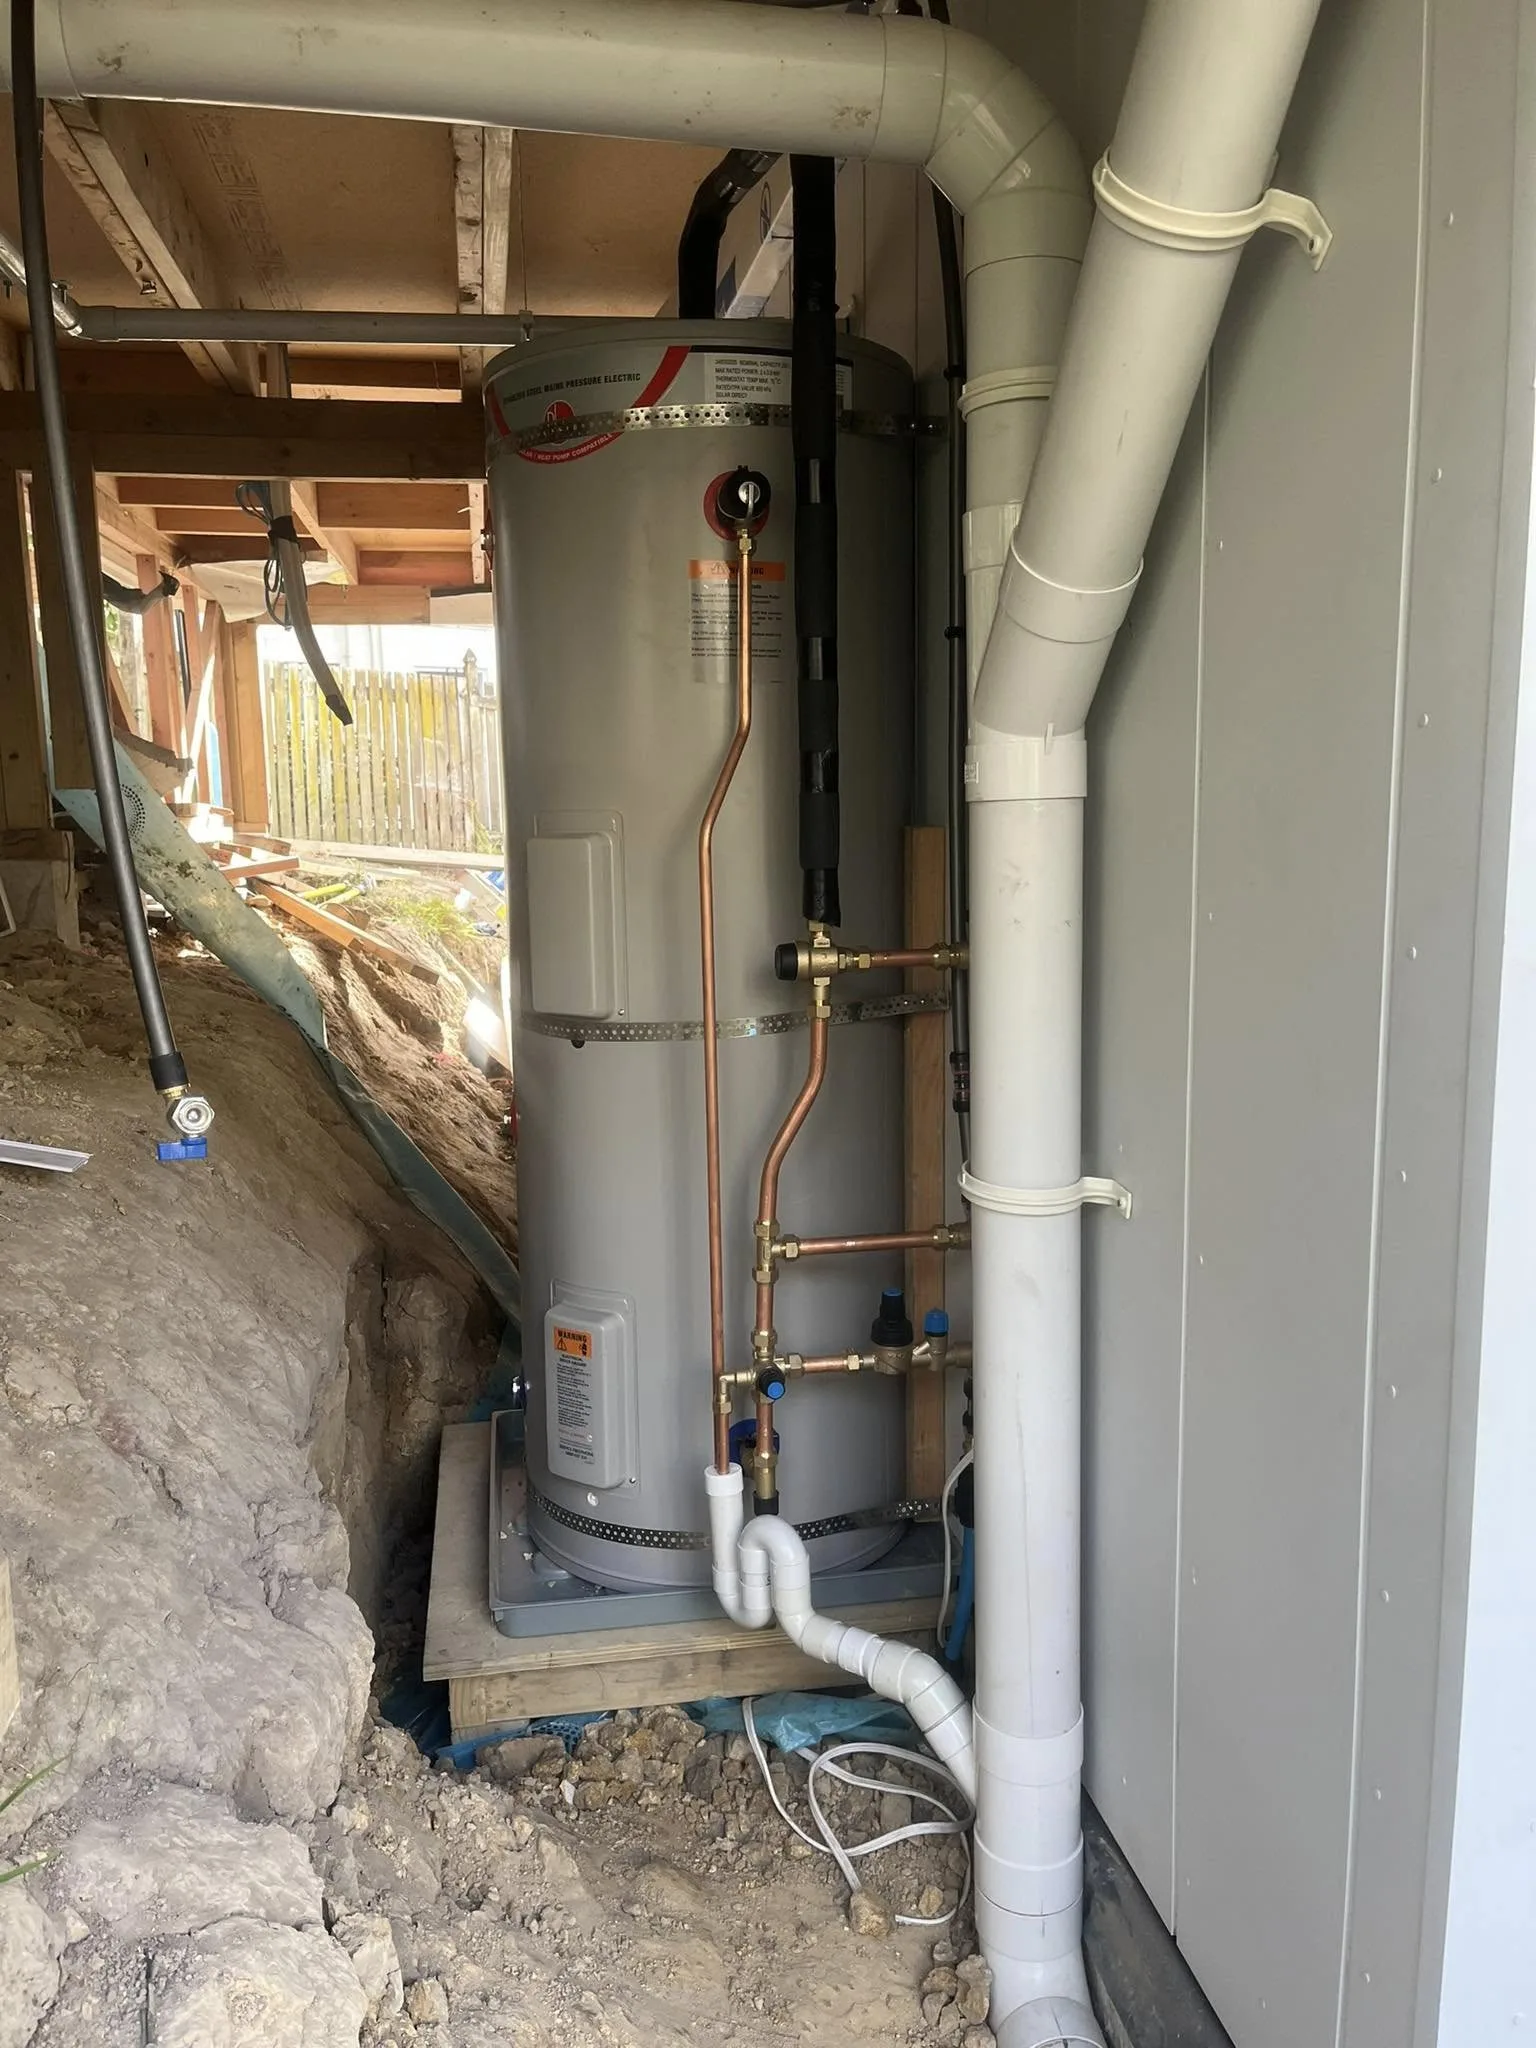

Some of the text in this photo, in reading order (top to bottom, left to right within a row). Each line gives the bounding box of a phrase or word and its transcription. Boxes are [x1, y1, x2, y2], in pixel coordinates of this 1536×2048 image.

[565, 375, 602, 389] PRESSURE
[604, 372, 641, 384] ELECTRIC
[558, 1329, 587, 1343] WARNING
